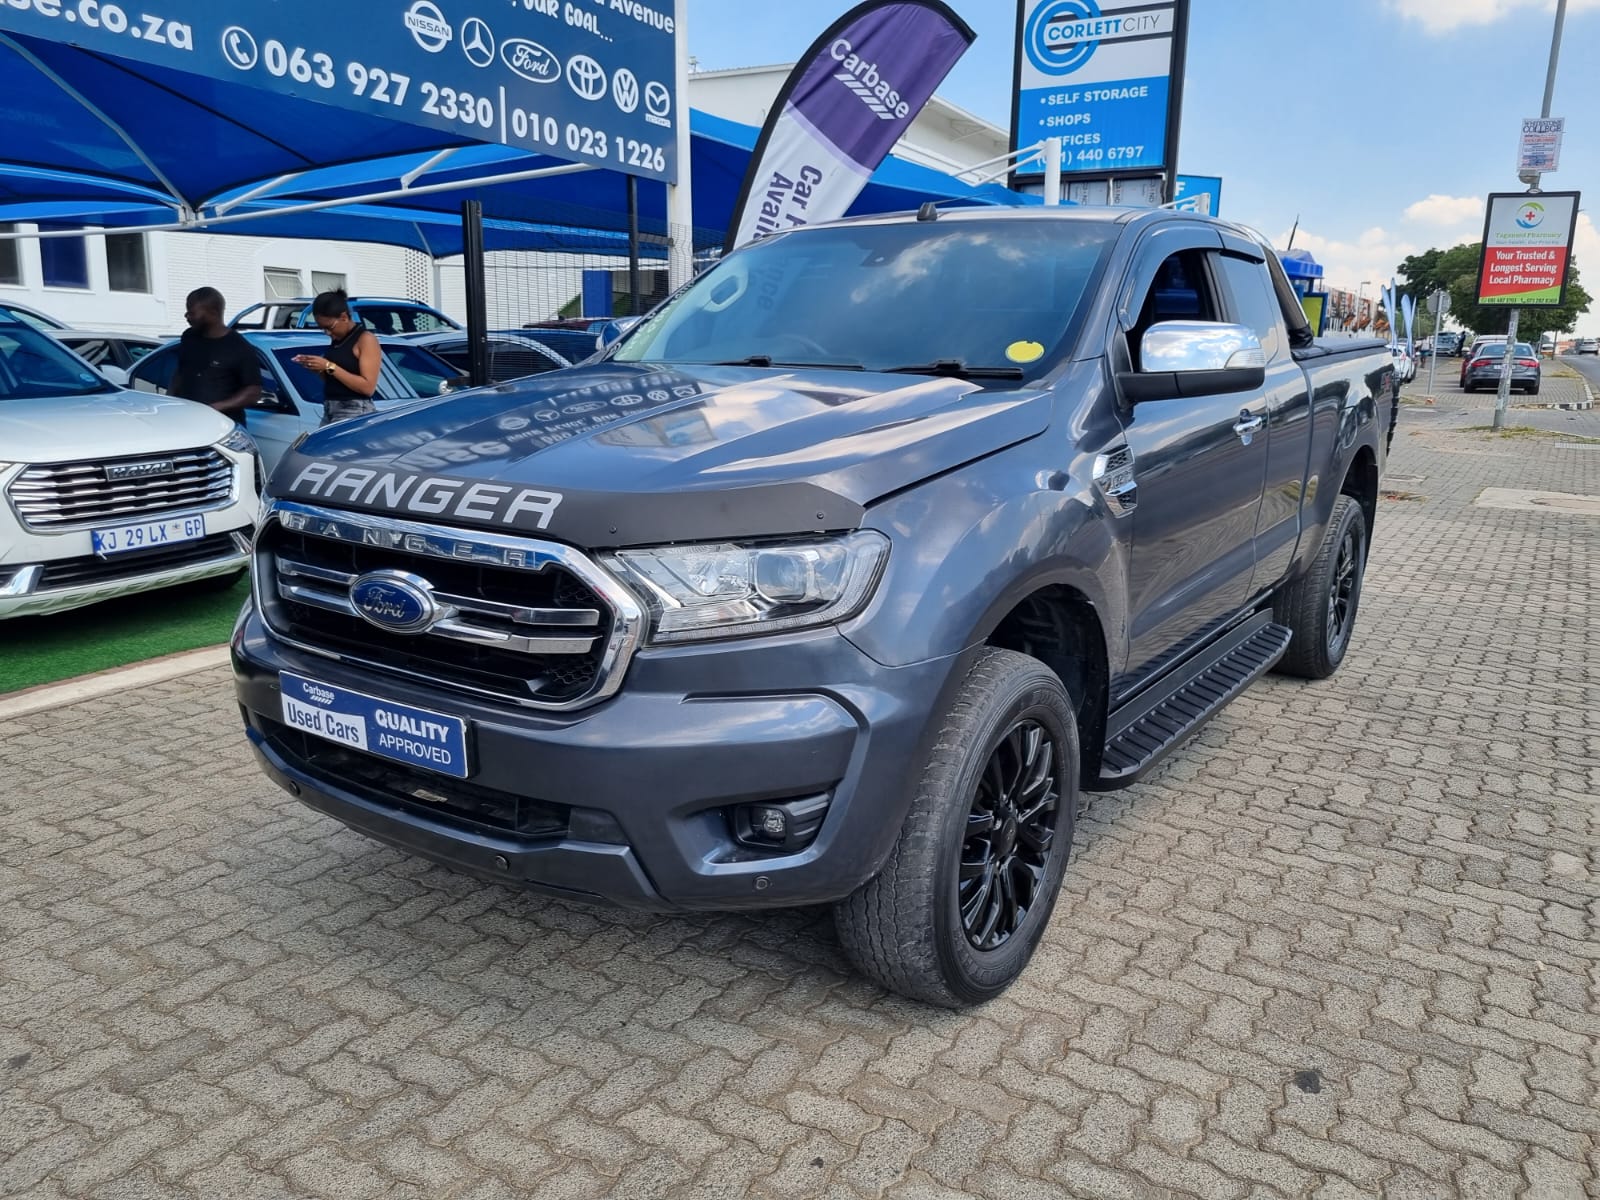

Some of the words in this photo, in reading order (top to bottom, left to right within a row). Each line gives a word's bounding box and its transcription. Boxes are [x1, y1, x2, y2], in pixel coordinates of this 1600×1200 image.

[0, 0, 193, 50] e.co.za
[407, 16, 451, 38] NISSAN
[512, 44, 550, 77] Ford
[830, 39, 910, 119] Carbase
[264, 39, 335, 89] 063
[347, 62, 411, 106] 927
[421, 82, 493, 128] 2330
[512, 108, 558, 146] 010
[565, 123, 608, 158] 023
[615, 137, 666, 172] 1226
[1048, 92, 1080, 106] SELF
[1084, 86, 1149, 103] STORAGE
[1046, 113, 1091, 127] SHOPS
[1077, 148, 1103, 161] 440
[1108, 145, 1144, 160] 6797
[791, 165, 823, 210] Car
[1490, 263, 1523, 274] Longest
[1525, 263, 1557, 274] Serving
[1496, 251, 1514, 260] Your
[1515, 250, 1547, 260] Trusted
[1548, 250, 1556, 260] &
[1489, 275, 1512, 284] Local
[1513, 275, 1555, 286] Pharmacy
[289, 462, 564, 530] RANGER
[126, 529, 144, 545] 29
[150, 526, 168, 543] LX
[185, 519, 201, 537] GP
[363, 586, 406, 618] Ford
[303, 682, 335, 701] Carbase
[287, 702, 321, 731] Used
[326, 714, 360, 743] Cars
[375, 709, 449, 743] QUALITY
[379, 733, 451, 765] APPROVED
